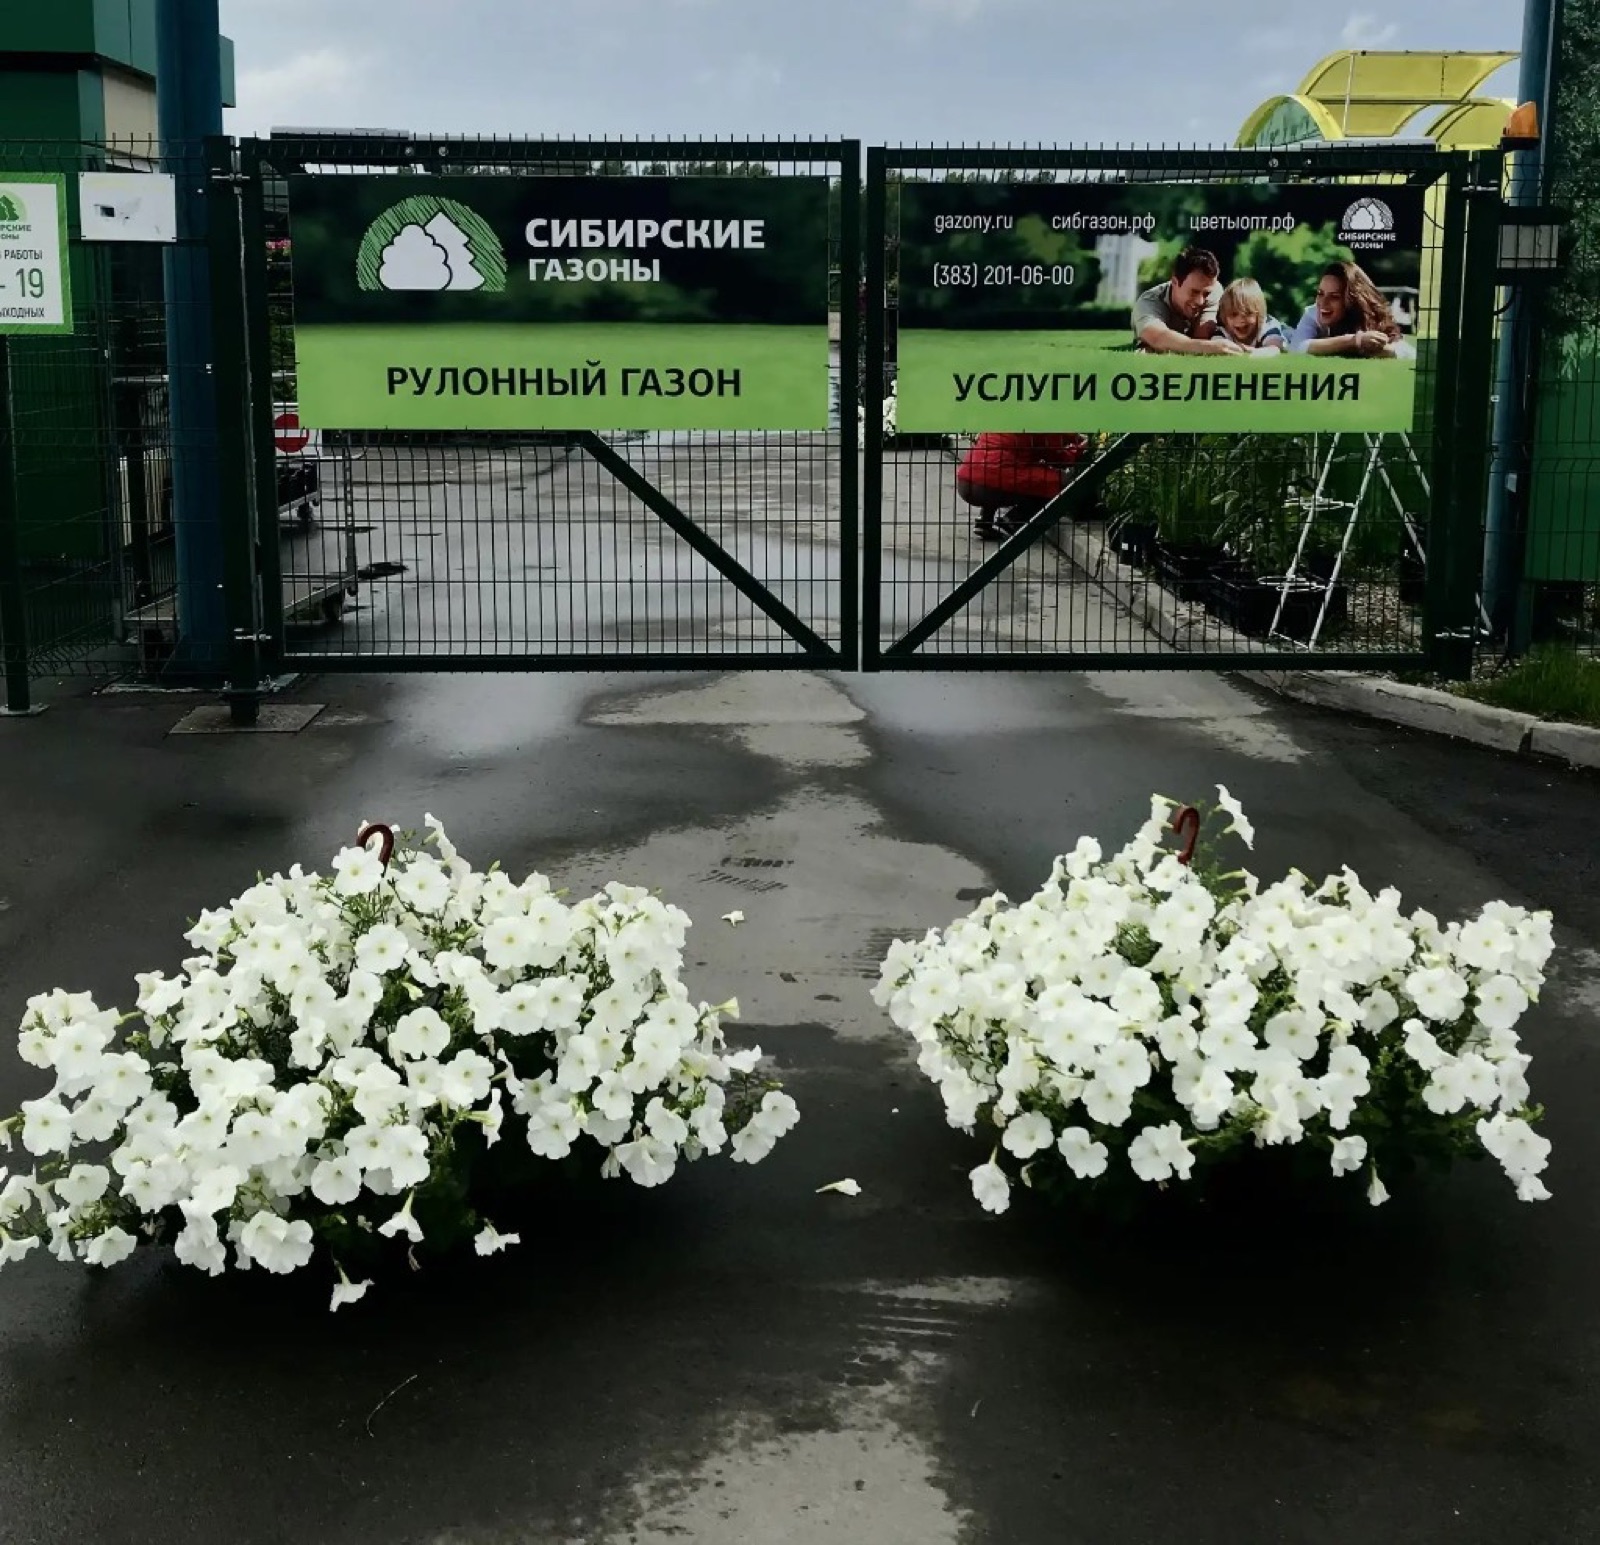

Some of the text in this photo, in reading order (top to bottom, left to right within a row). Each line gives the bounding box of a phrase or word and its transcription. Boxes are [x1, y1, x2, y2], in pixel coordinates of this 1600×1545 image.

[0, 224, 32, 232] РСКИЕ
[525, 218, 765, 249] СИБИРСКИЕ
[934, 213, 1013, 235] gazony.ru
[1052, 211, 1156, 235] сибгазон.рф
[1190, 212, 1295, 234] цветыопт.рф
[1338, 232, 1396, 241] СИБИРСКИЕ
[1350, 241, 1384, 249] ГАЗОНЫ
[4, 249, 43, 260] РАБОТЫ
[528, 257, 660, 282] ГАЗОНЫ
[933, 262, 1074, 288] (383) 201-06-00
[15, 267, 45, 298] 19
[387, 359, 741, 397] РУЛОННЫЙ ГАЗОН
[952, 372, 1360, 402] УСЛУГИ ОЗЕЛЕНЕНИЯ
